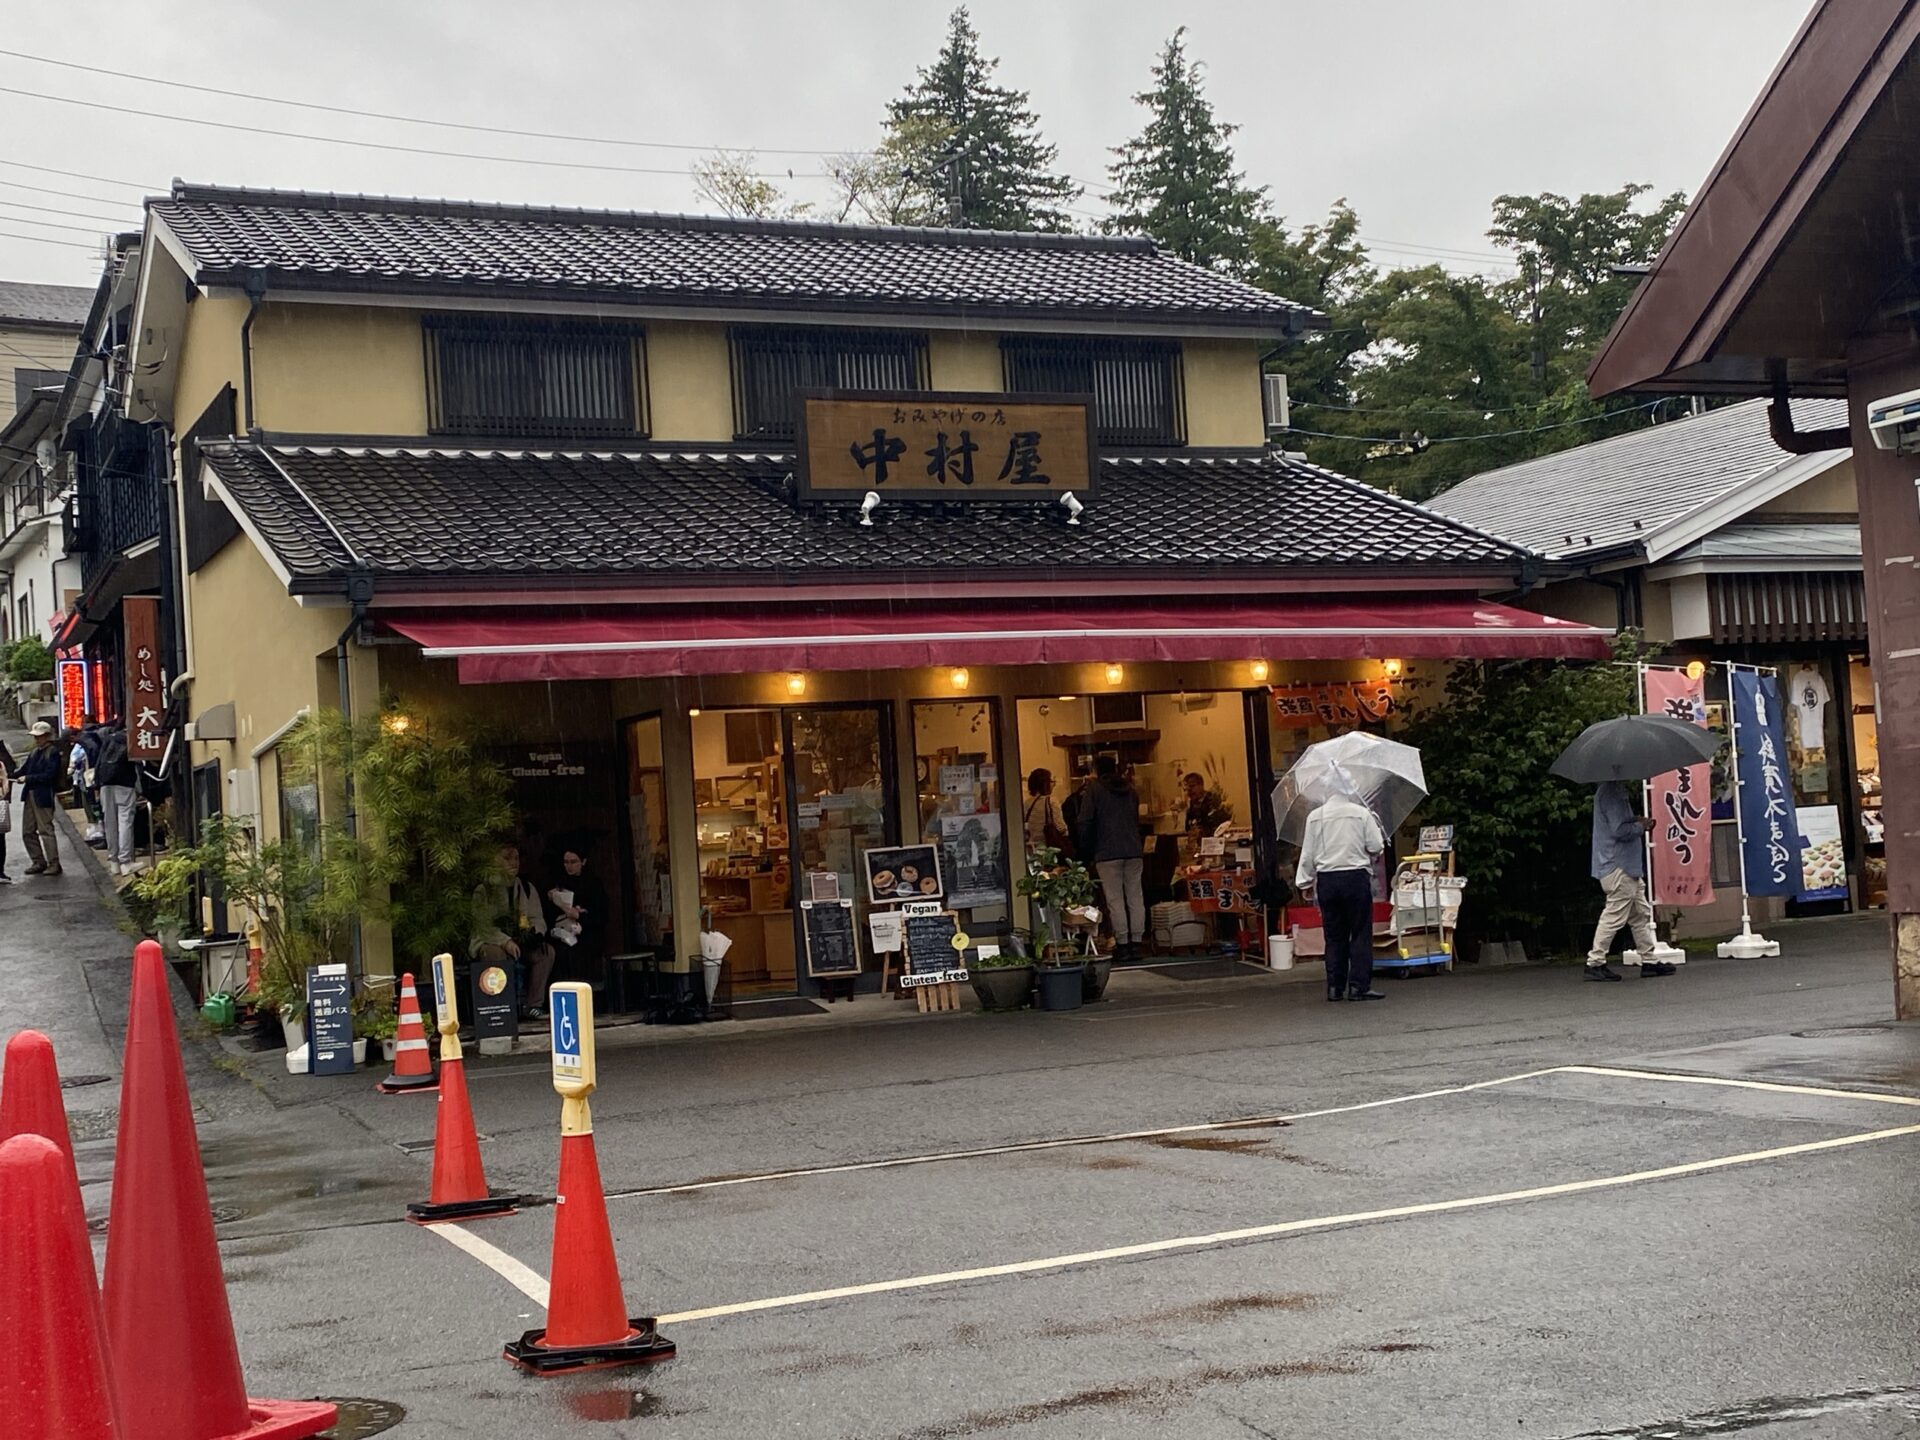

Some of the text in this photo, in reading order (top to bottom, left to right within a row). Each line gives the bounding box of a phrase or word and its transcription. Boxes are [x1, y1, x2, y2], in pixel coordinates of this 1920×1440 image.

[893, 407, 1007, 425] おみやげの店
[849, 428, 1051, 486] 中村屋
[136, 647, 155, 692] めし処
[529, 752, 562, 765] Vegan
[903, 904, 938, 915] Vegan
